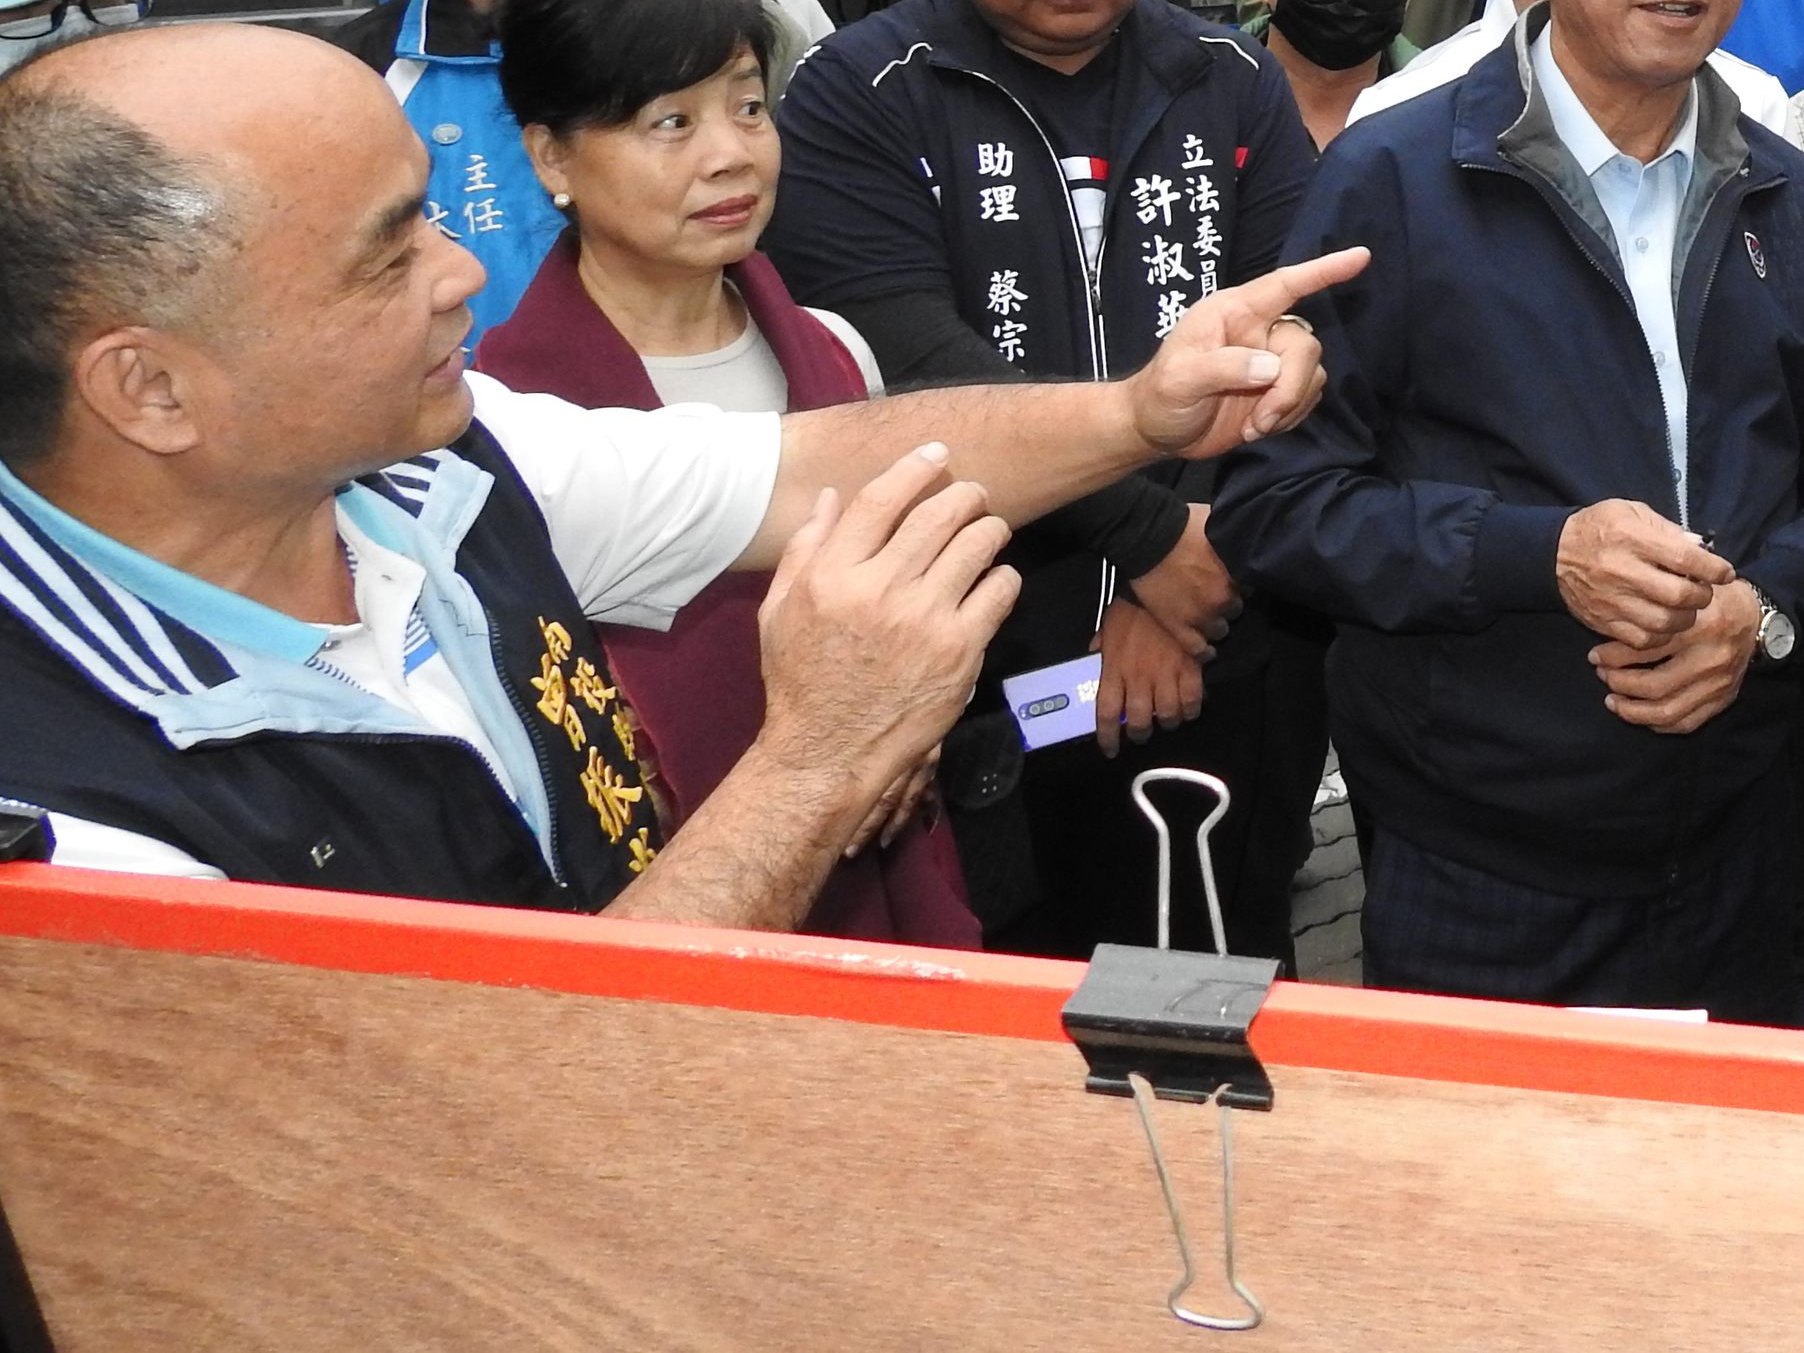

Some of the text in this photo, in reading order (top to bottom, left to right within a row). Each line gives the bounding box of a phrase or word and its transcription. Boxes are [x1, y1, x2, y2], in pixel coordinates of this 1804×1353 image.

[463, 154, 504, 235] 主任
[977, 142, 1029, 375] 助理 蔡宗
[1181, 134, 1223, 300] 立法委員
